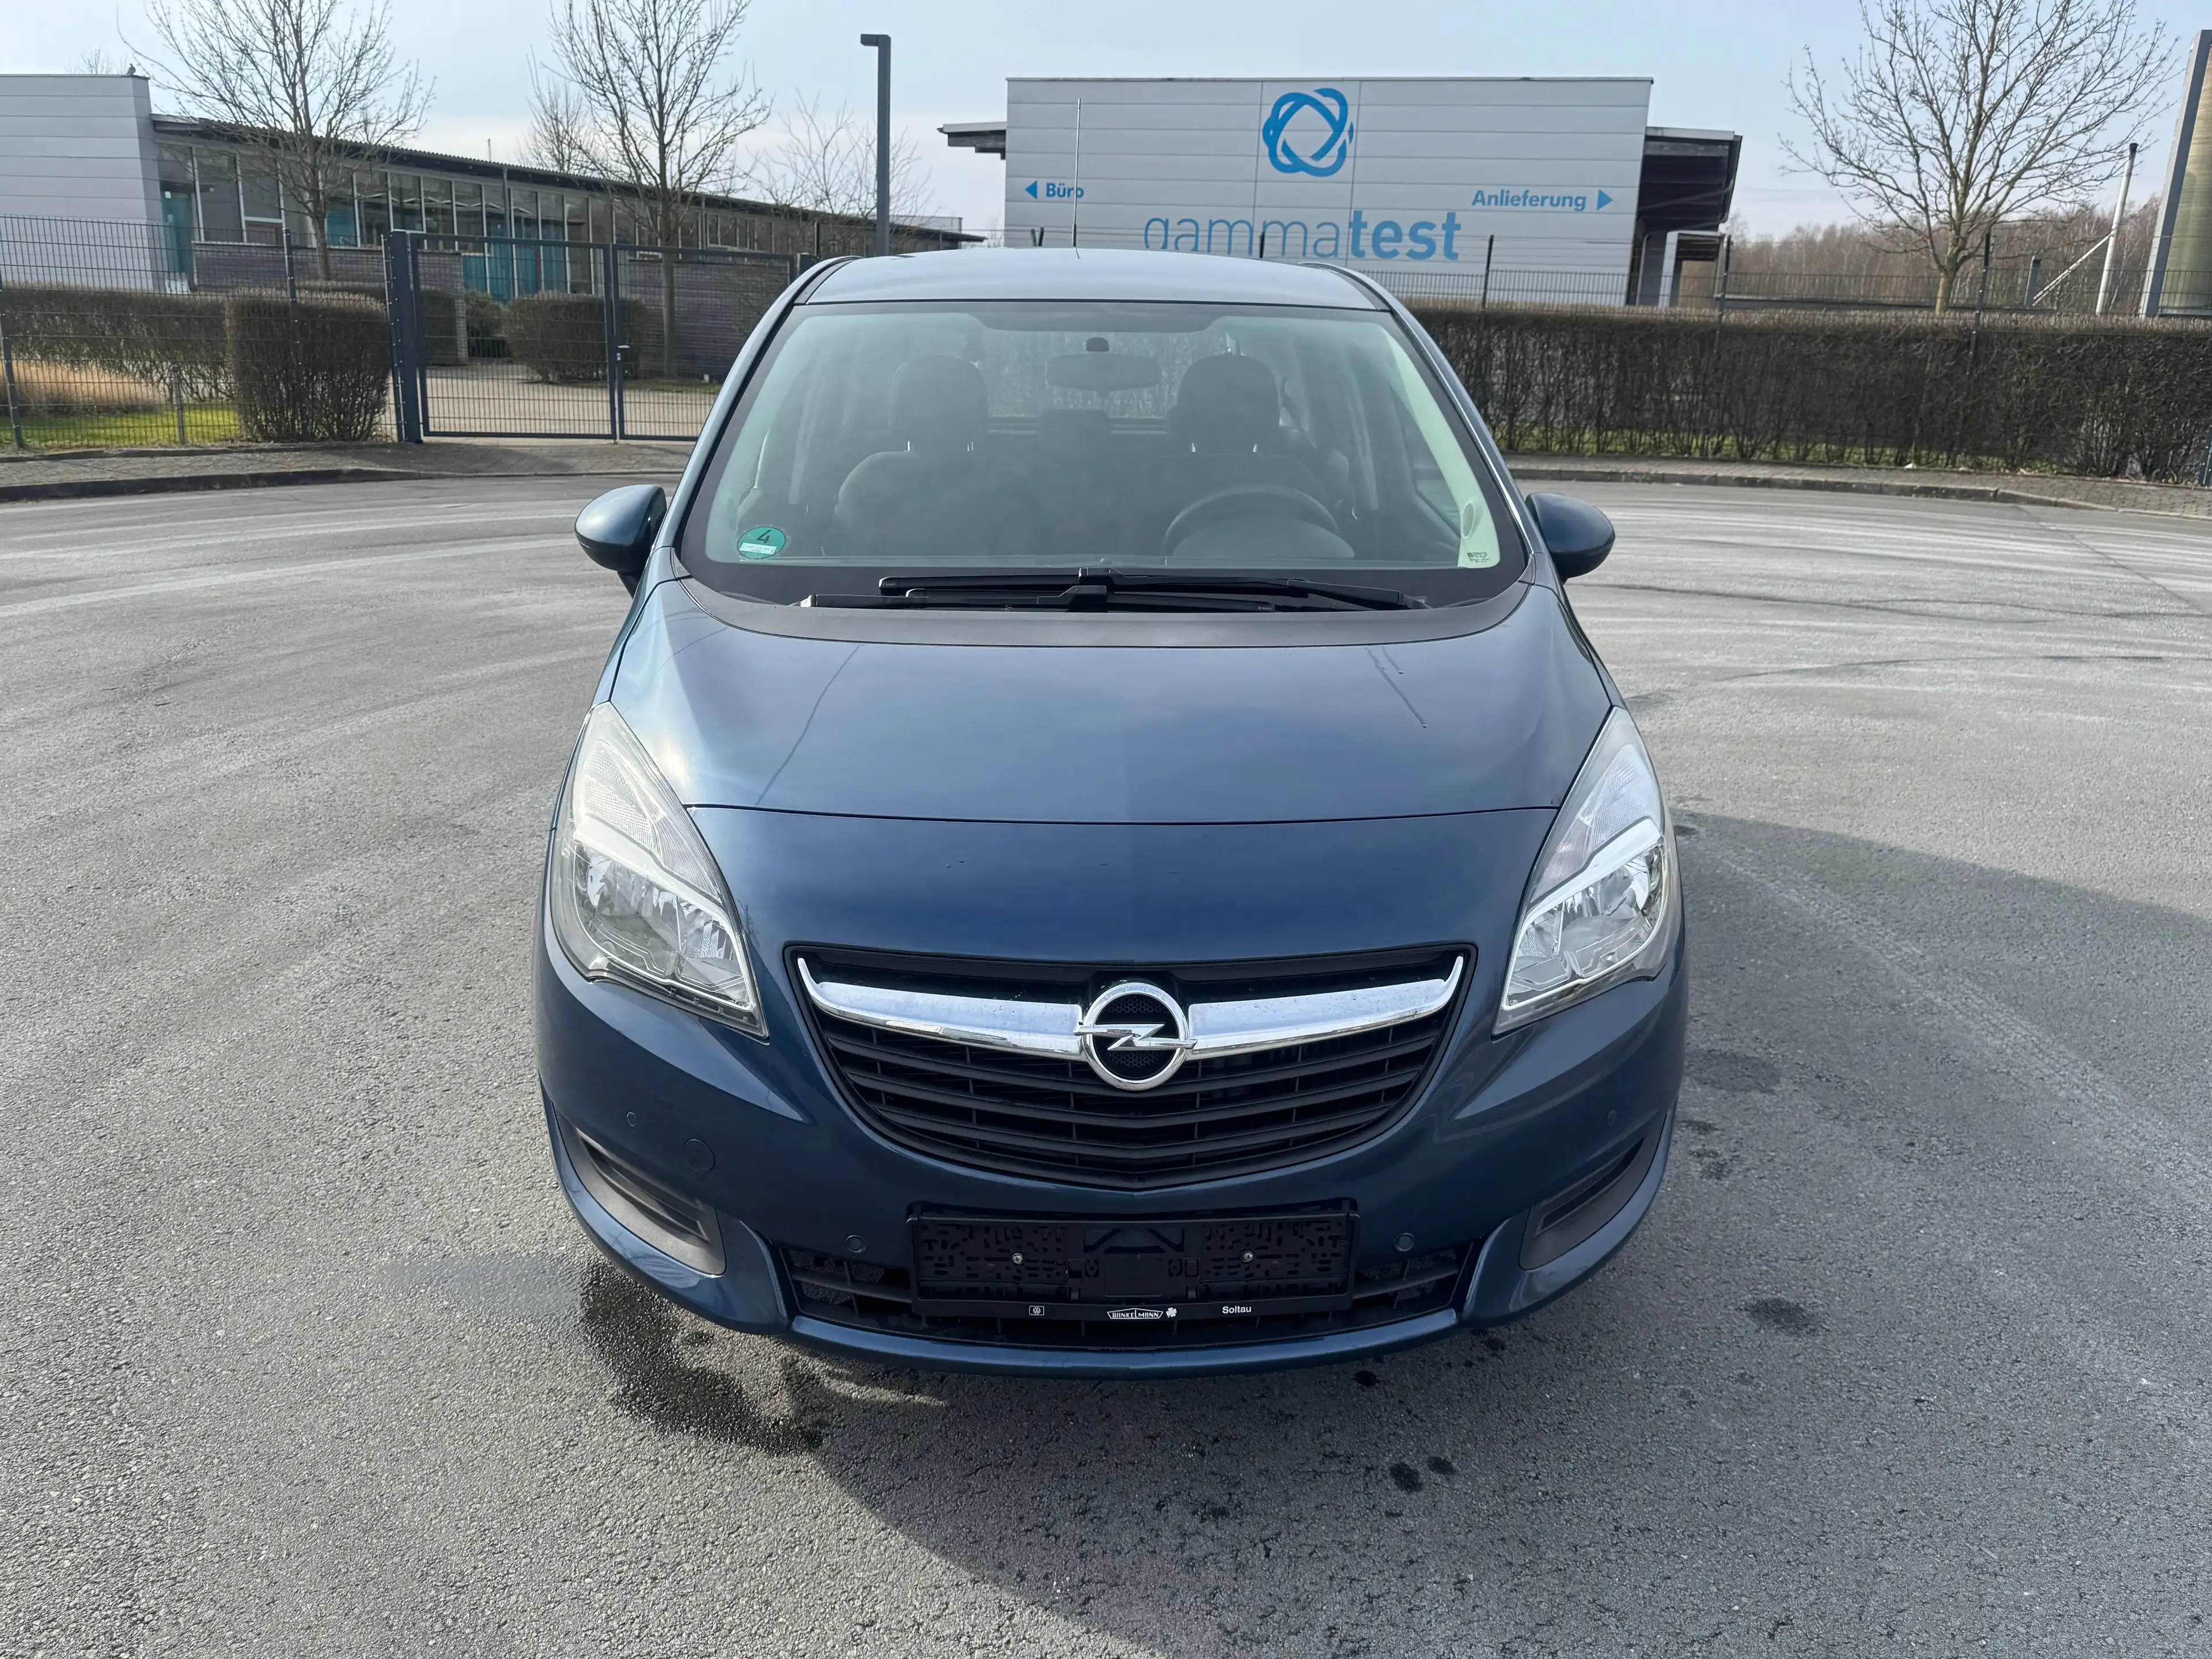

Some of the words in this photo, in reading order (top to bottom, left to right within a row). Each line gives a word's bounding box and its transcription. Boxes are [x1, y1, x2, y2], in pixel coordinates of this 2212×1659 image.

[1046, 182, 1084, 198] Büro
[1472, 190, 1587, 211] Anlieferung
[1144, 210, 1461, 260] gammatest
[756, 529, 772, 544] 4
[1222, 1305, 1251, 1313] Soltau
